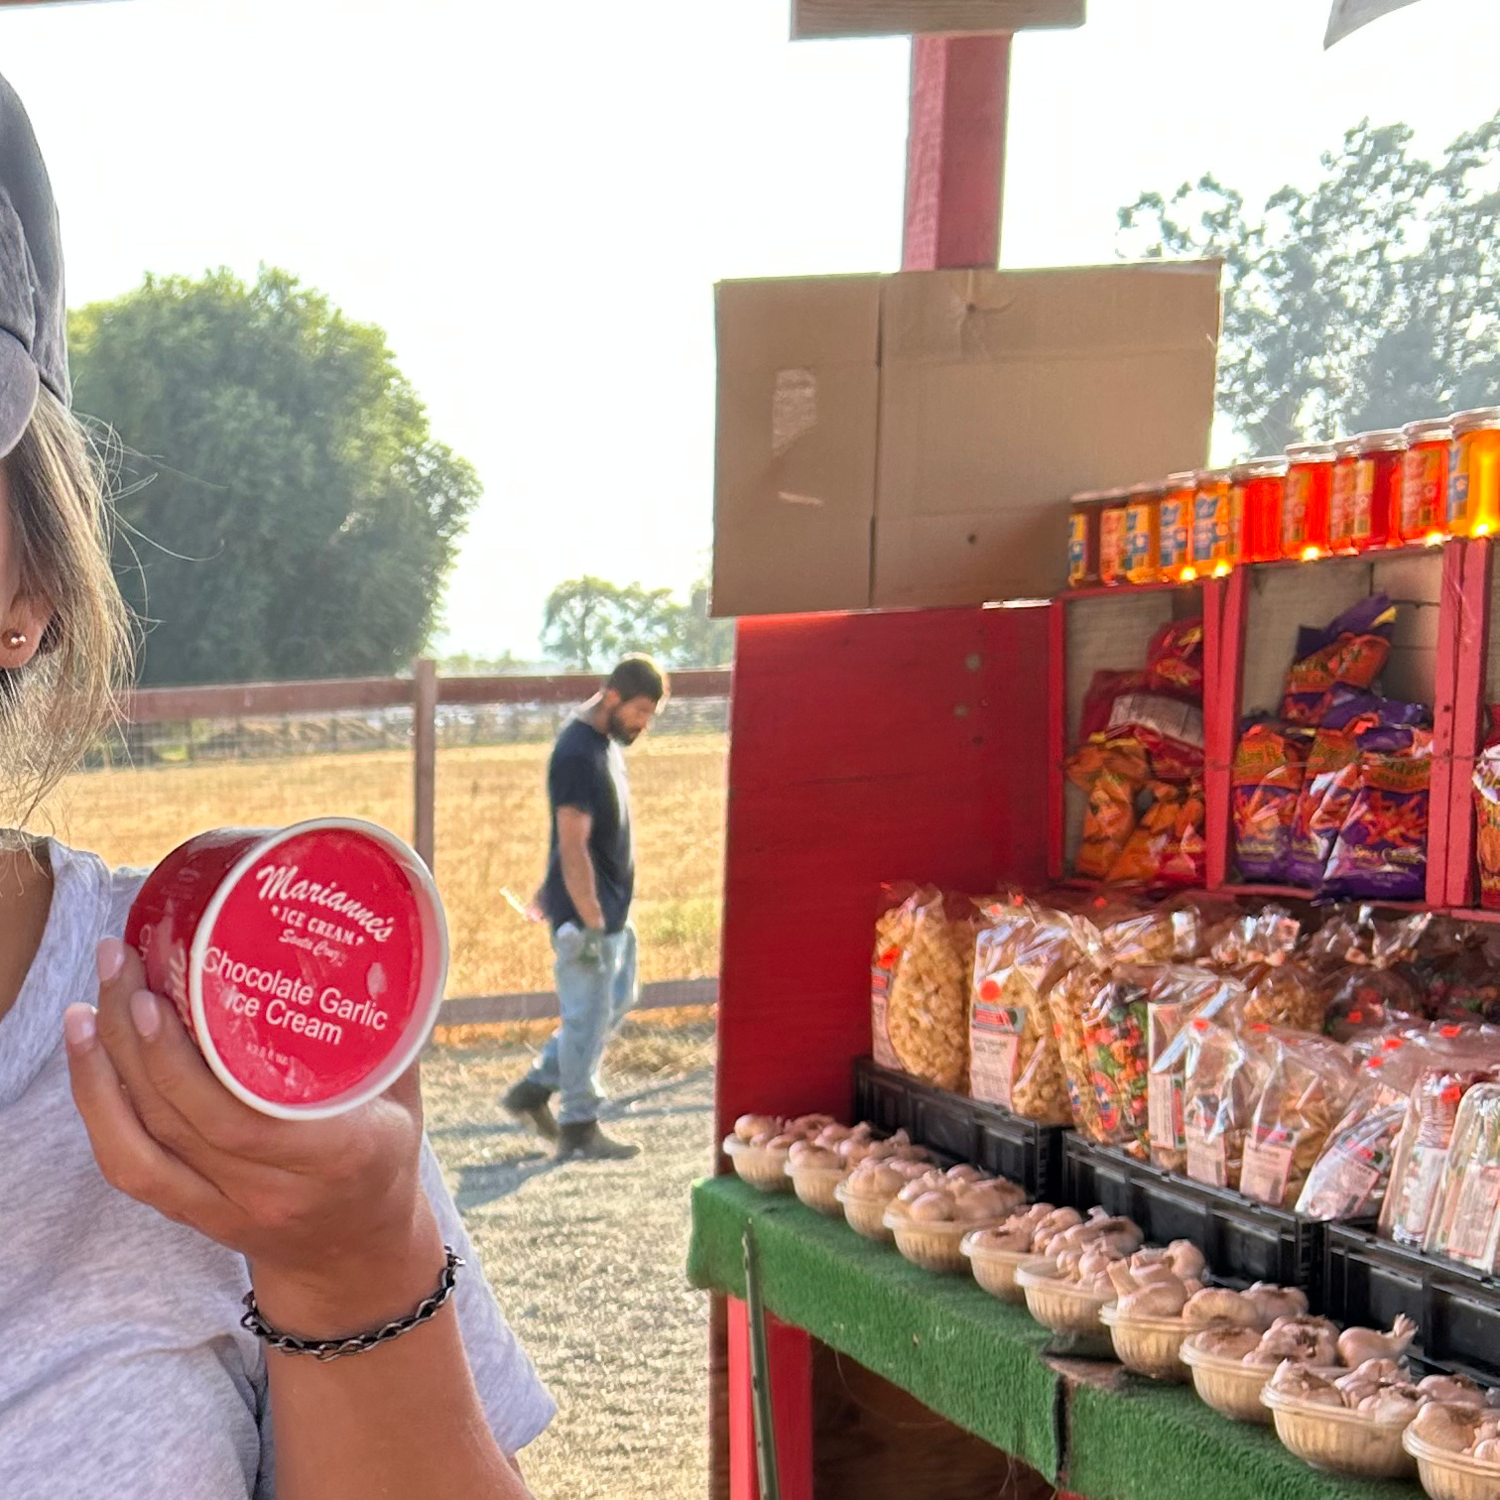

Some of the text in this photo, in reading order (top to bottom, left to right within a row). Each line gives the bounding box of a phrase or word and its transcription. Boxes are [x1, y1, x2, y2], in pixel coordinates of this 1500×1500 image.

[255, 864, 396, 943] Marianne's
[281, 906, 356, 946] ICE CREAM
[202, 946, 389, 1032] Chocolate Garlic
[224, 984, 343, 1045] Ice Cream
